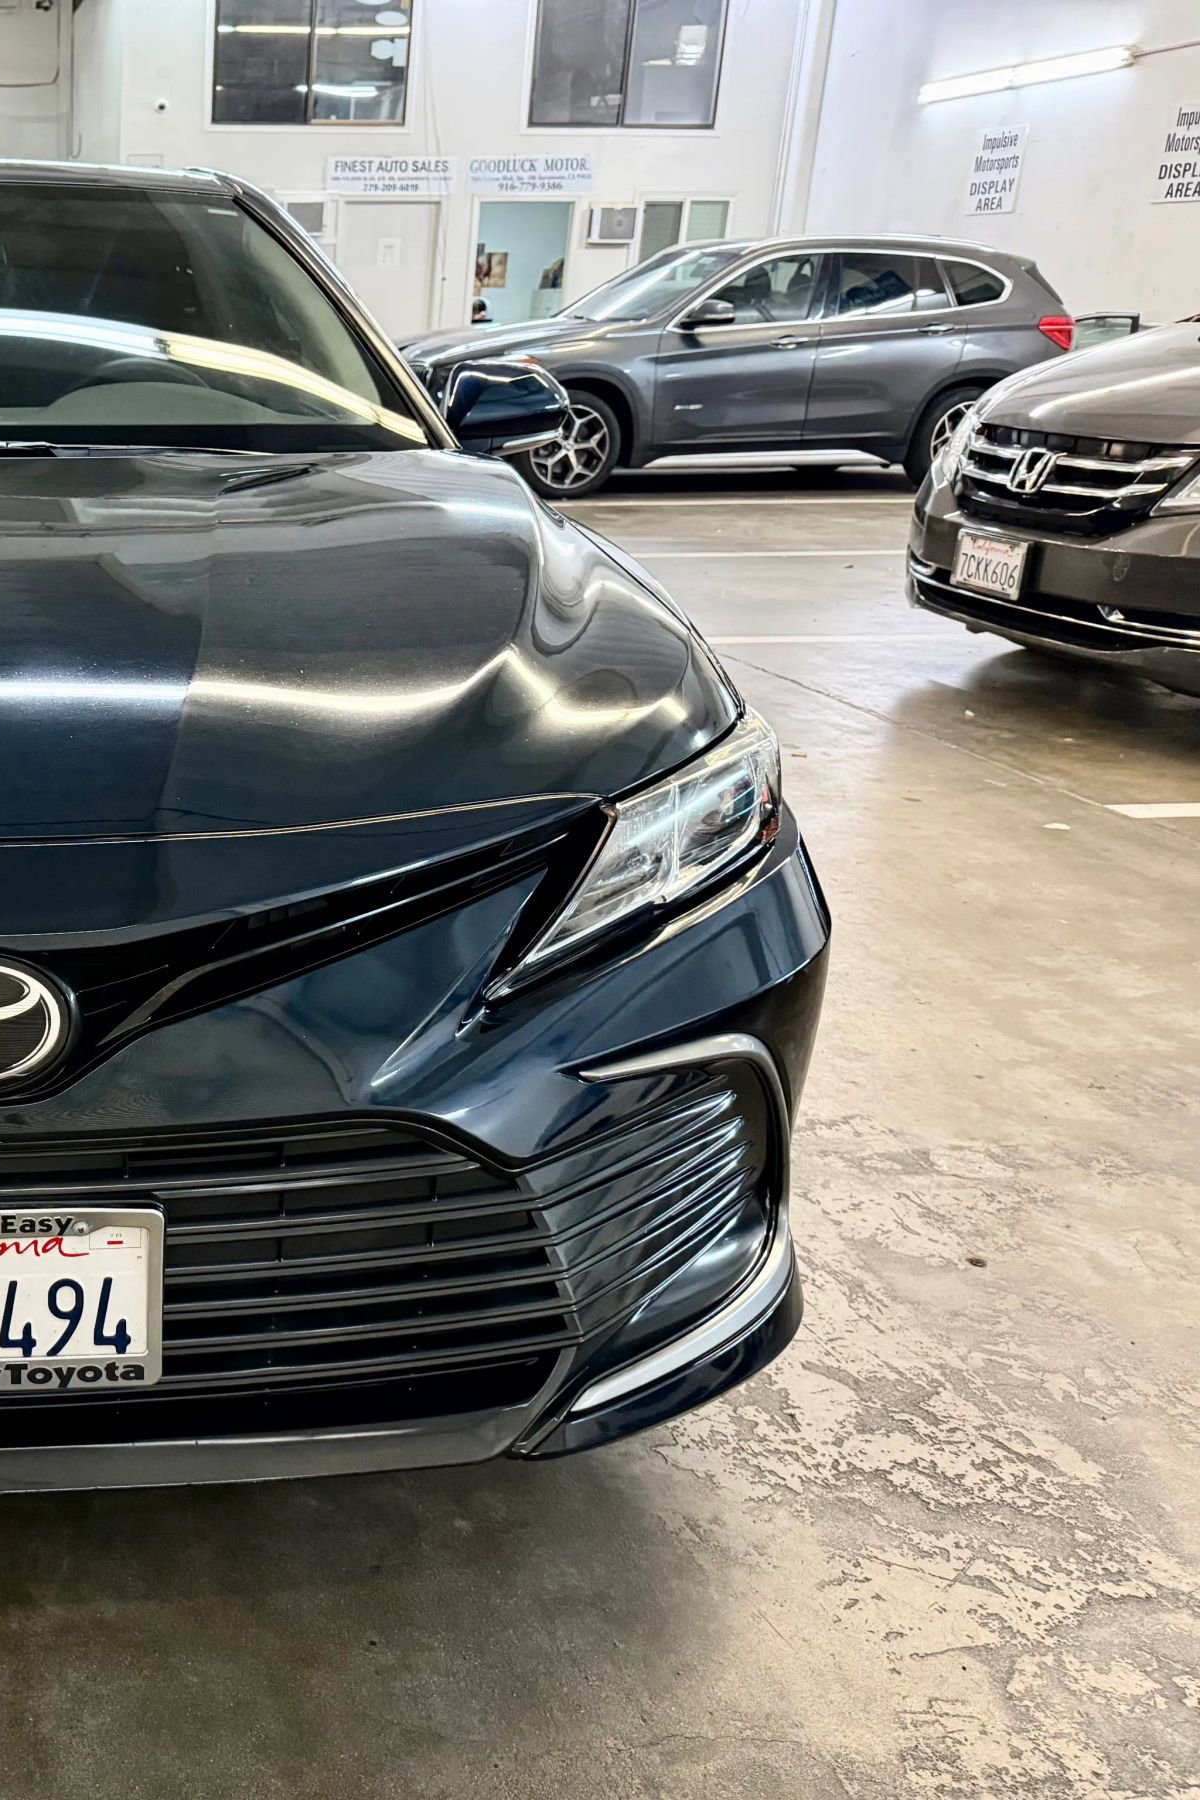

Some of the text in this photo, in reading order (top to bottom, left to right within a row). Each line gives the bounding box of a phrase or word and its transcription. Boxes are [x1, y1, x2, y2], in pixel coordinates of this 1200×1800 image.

[982, 131, 1019, 153] Impulsive
[1164, 132, 1200, 154] Motors
[334, 160, 449, 172] FINEST AUTO SALES
[470, 158, 537, 173] GOODLUCK
[974, 154, 1019, 174] Motorsports
[1158, 162, 1200, 180] DISPL
[969, 178, 1015, 196] DISPLAY
[1164, 181, 1200, 199] AREA
[975, 196, 1003, 212] AREA
[960, 552, 1019, 589] 7CKK606
[1, 1215, 74, 1236] Easy
[4, 1363, 145, 1388] Toyota
